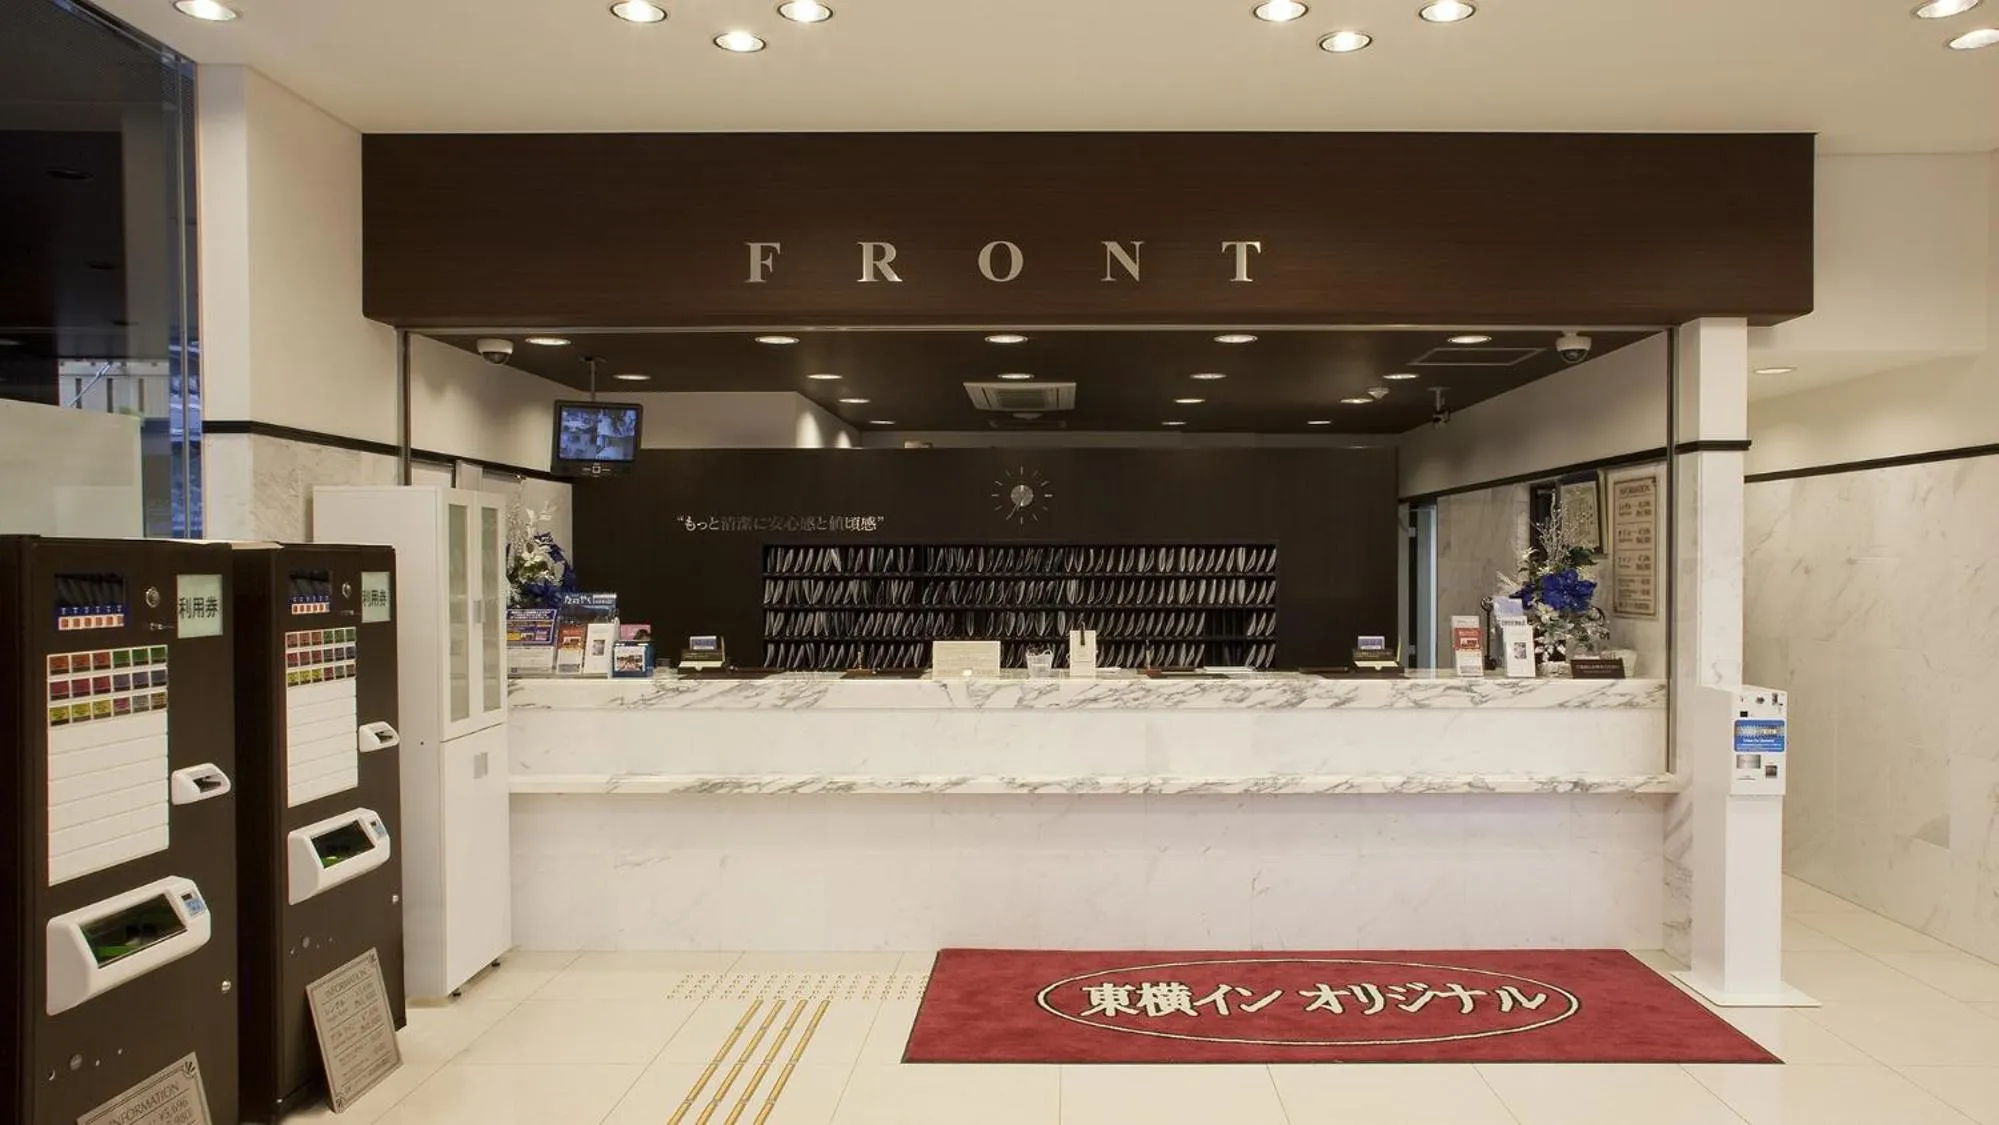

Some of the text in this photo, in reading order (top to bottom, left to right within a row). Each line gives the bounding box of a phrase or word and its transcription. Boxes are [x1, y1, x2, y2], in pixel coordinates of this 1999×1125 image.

[744, 240, 1262, 283] FRONT
[178, 595, 219, 620] 利用券
[1080, 982, 1549, 1018] 東横イン オリジナル
[109, 1079, 180, 1125] INFORMATION
